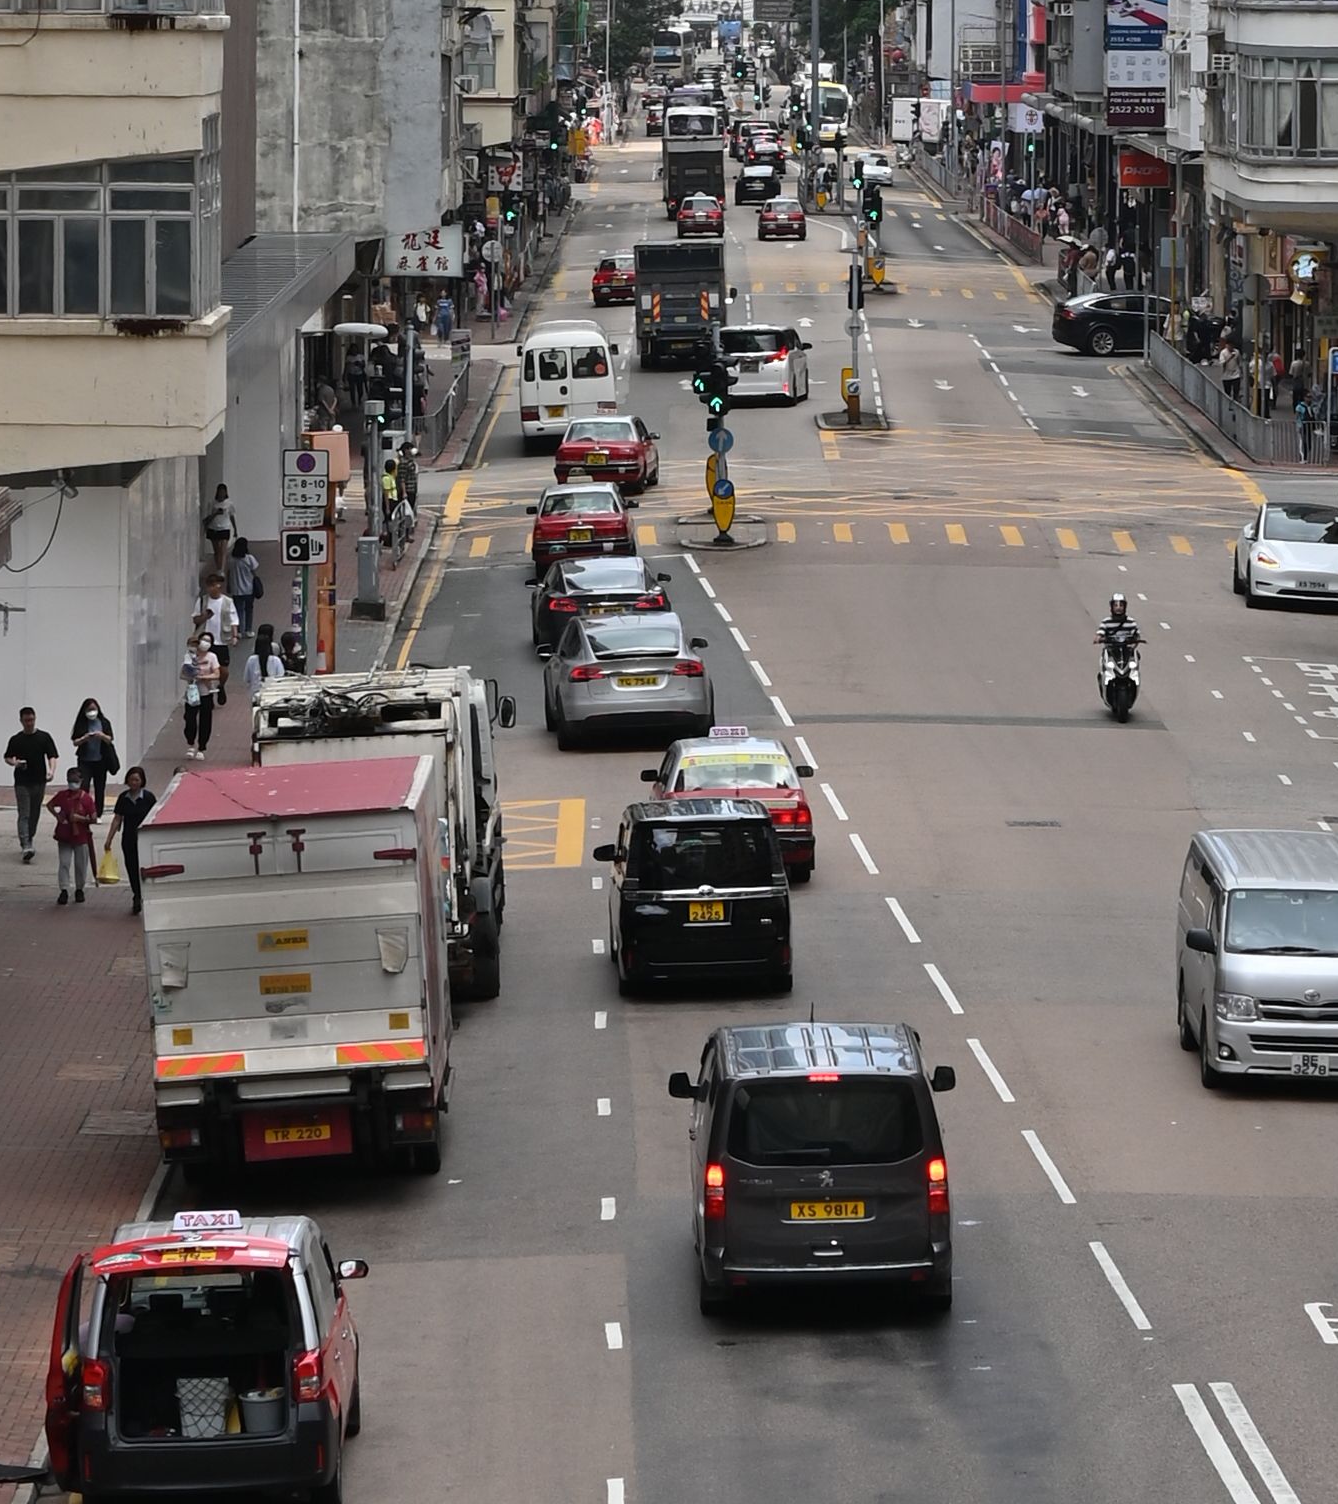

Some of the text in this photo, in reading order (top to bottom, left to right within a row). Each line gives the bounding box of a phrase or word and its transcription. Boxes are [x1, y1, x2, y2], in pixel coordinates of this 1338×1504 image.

[396, 255, 449, 272] 麻雀館
[300, 479, 326, 489] 8-10
[301, 494, 322, 502] 5-7
[692, 911, 722, 921] 2425
[1302, 1055, 1319, 1066] BE
[1293, 1065, 1327, 1076] 3278
[272, 1128, 323, 1141] TR 220
[795, 1204, 860, 1218] XS 9814
[179, 1213, 236, 1227] TAXI
